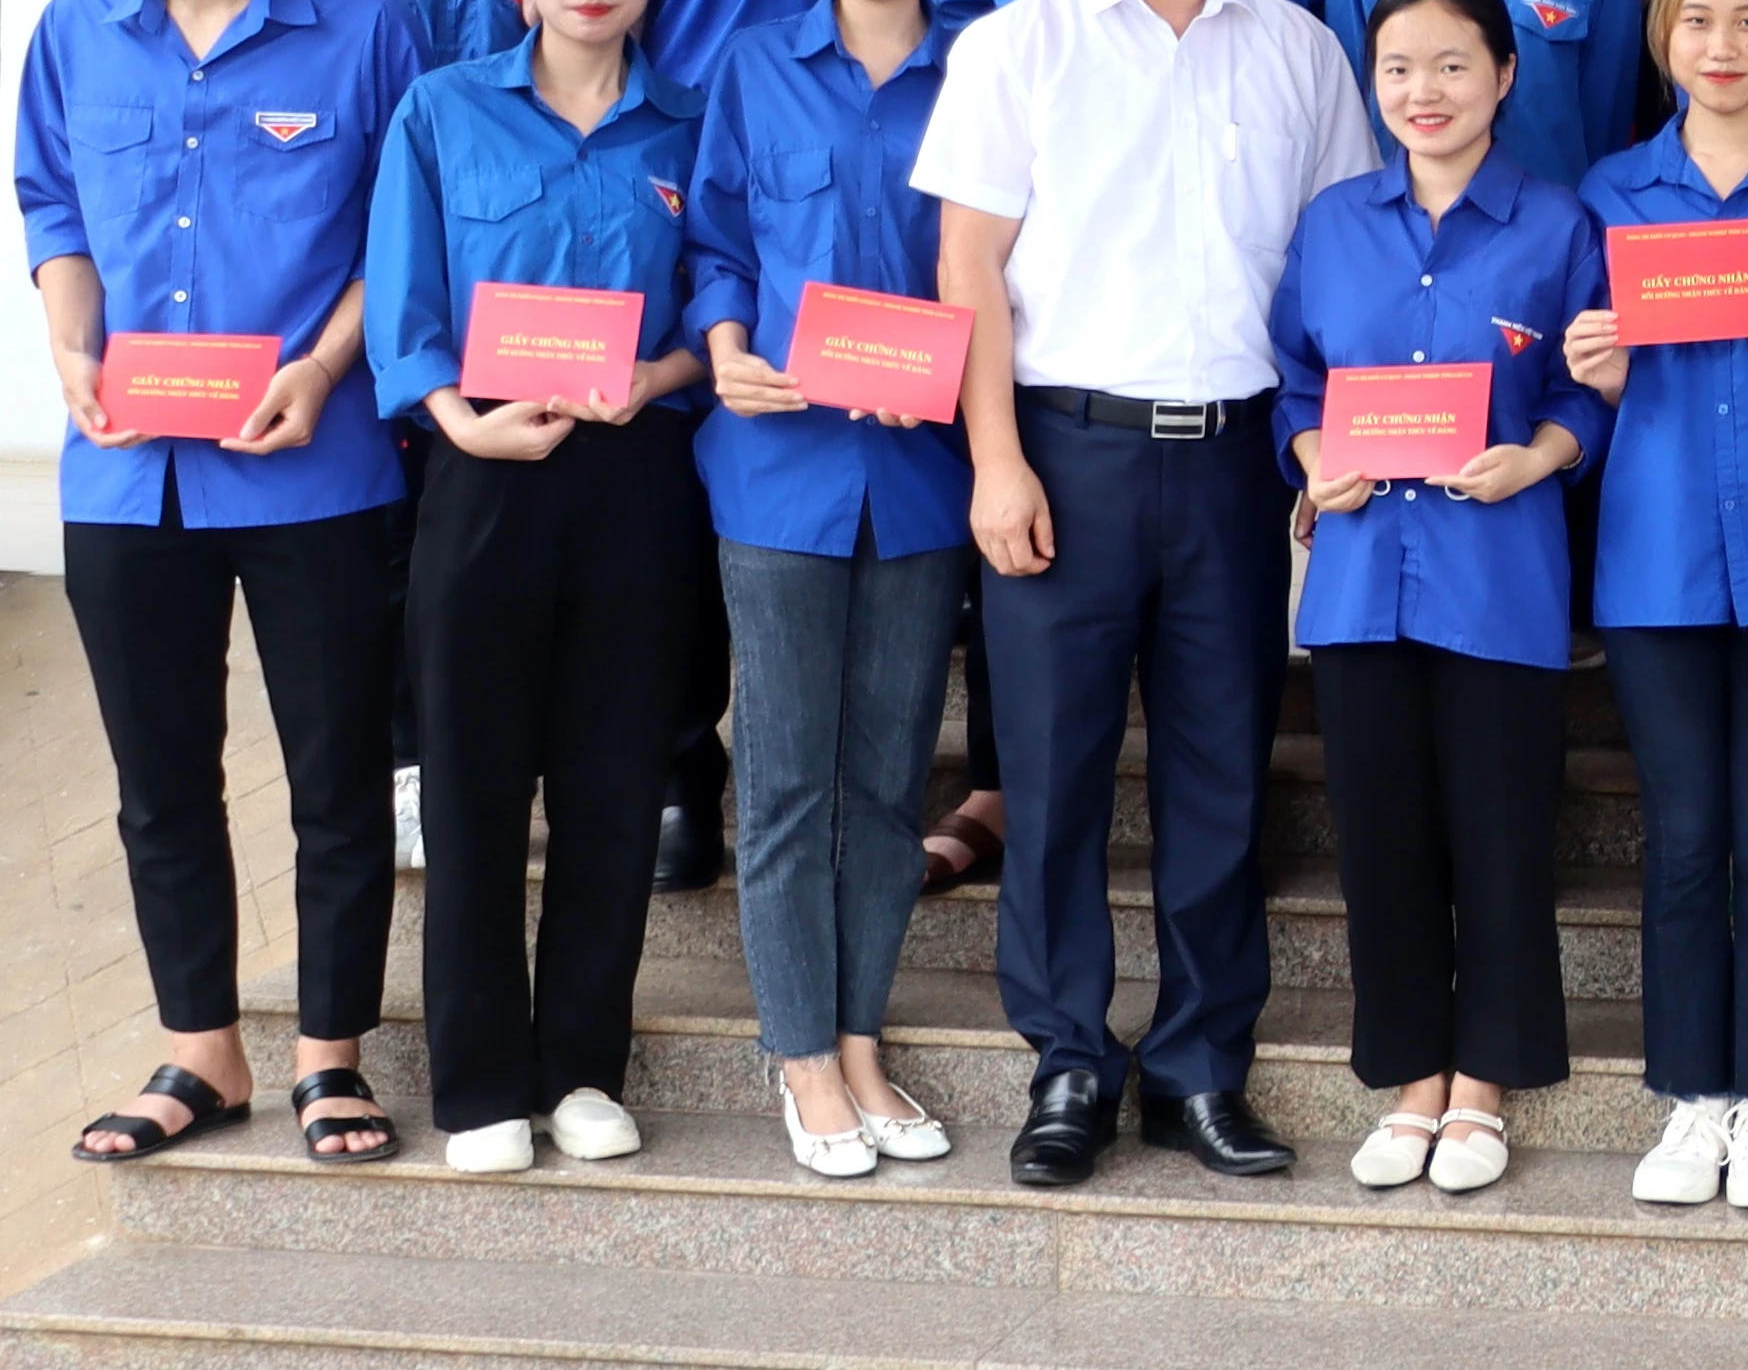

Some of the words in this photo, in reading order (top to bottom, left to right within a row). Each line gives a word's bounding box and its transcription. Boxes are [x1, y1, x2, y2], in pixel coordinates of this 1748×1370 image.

[1642, 274, 1672, 289] GIẤY
[1674, 271, 1715, 287] CHỨNG
[825, 333, 855, 351] GIẤY
[856, 338, 898, 358] CHỨNG
[900, 345, 934, 363] NHẬN
[1353, 412, 1380, 425] GIẤY
[1382, 411, 1421, 425] CHỨNG
[1425, 411, 1455, 424] NHẬN
